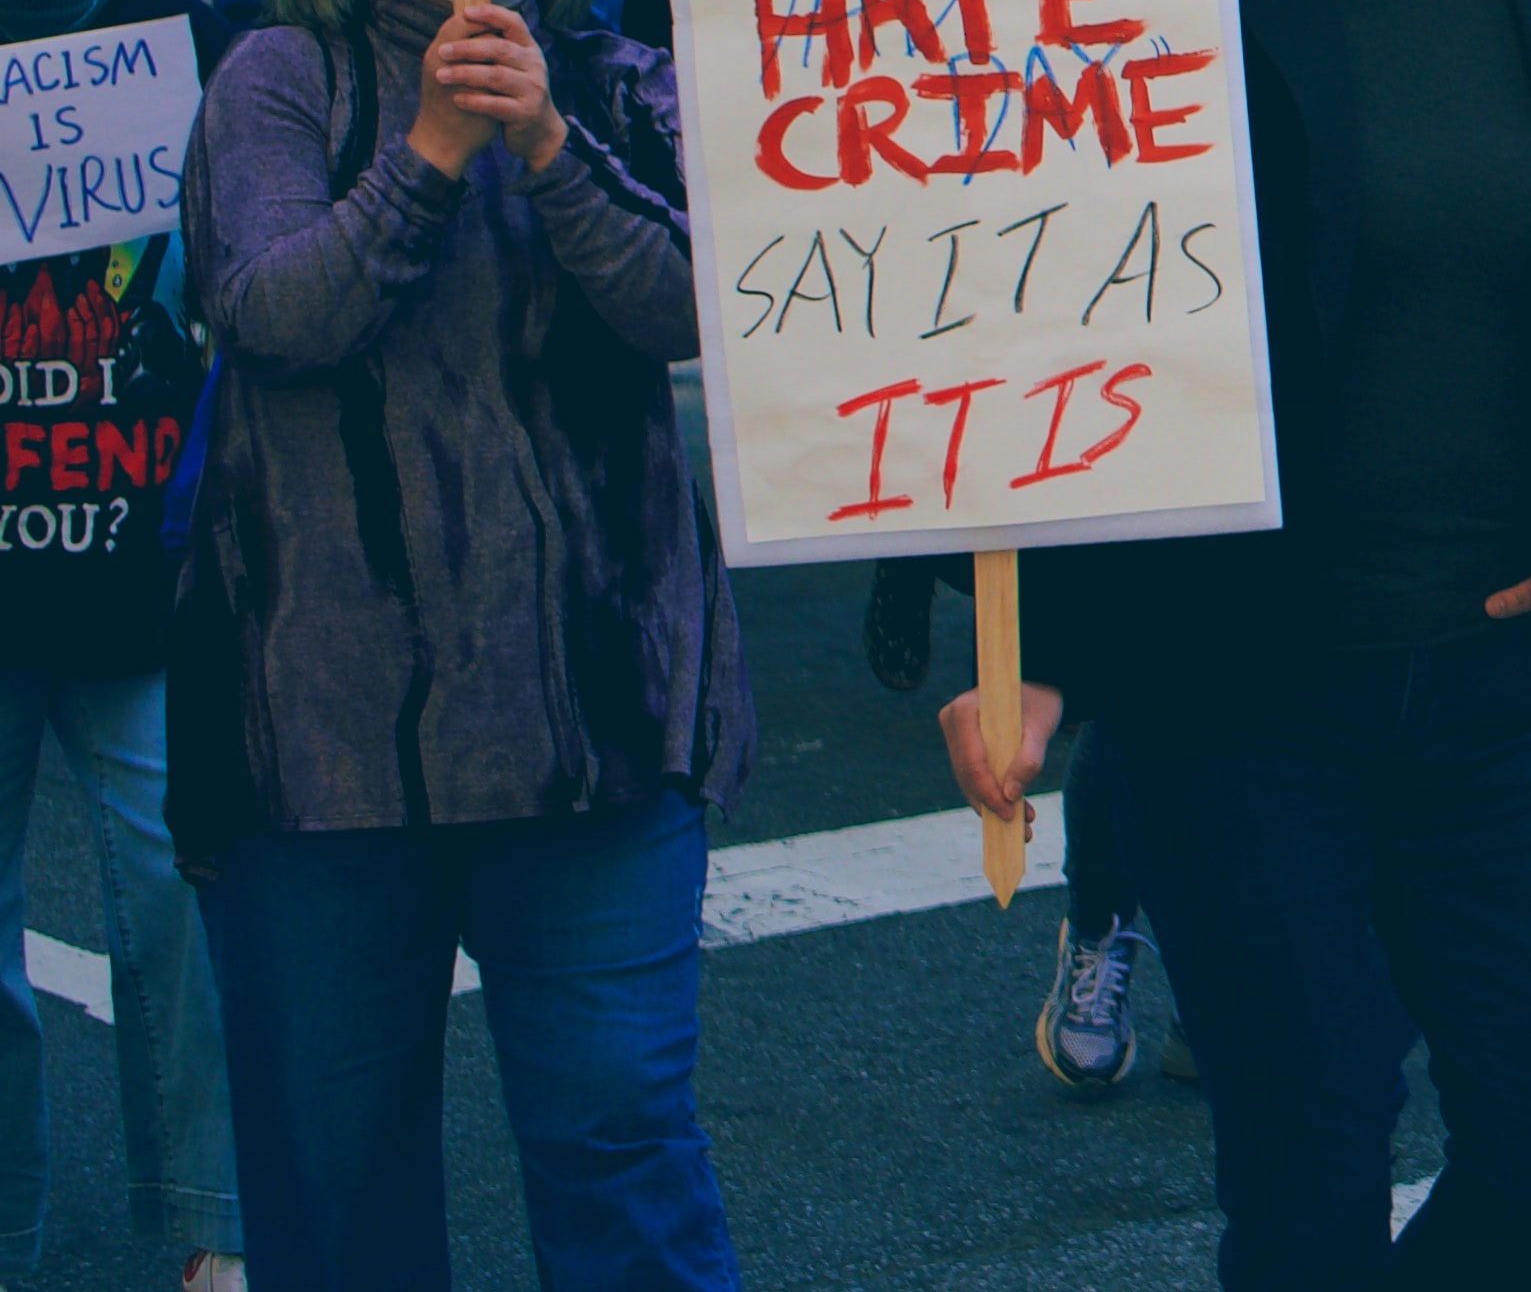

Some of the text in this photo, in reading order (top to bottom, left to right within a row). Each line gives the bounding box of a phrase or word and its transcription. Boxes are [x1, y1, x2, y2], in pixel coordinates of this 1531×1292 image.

[0, 38, 158, 105] ACISM
[755, 50, 1218, 191] CRIME
[30, 105, 84, 151] IS
[0, 145, 184, 244] VIRUS
[737, 203, 1223, 338] SAY IT AS
[98, 358, 117, 405] I
[828, 359, 1152, 520] IT IS
